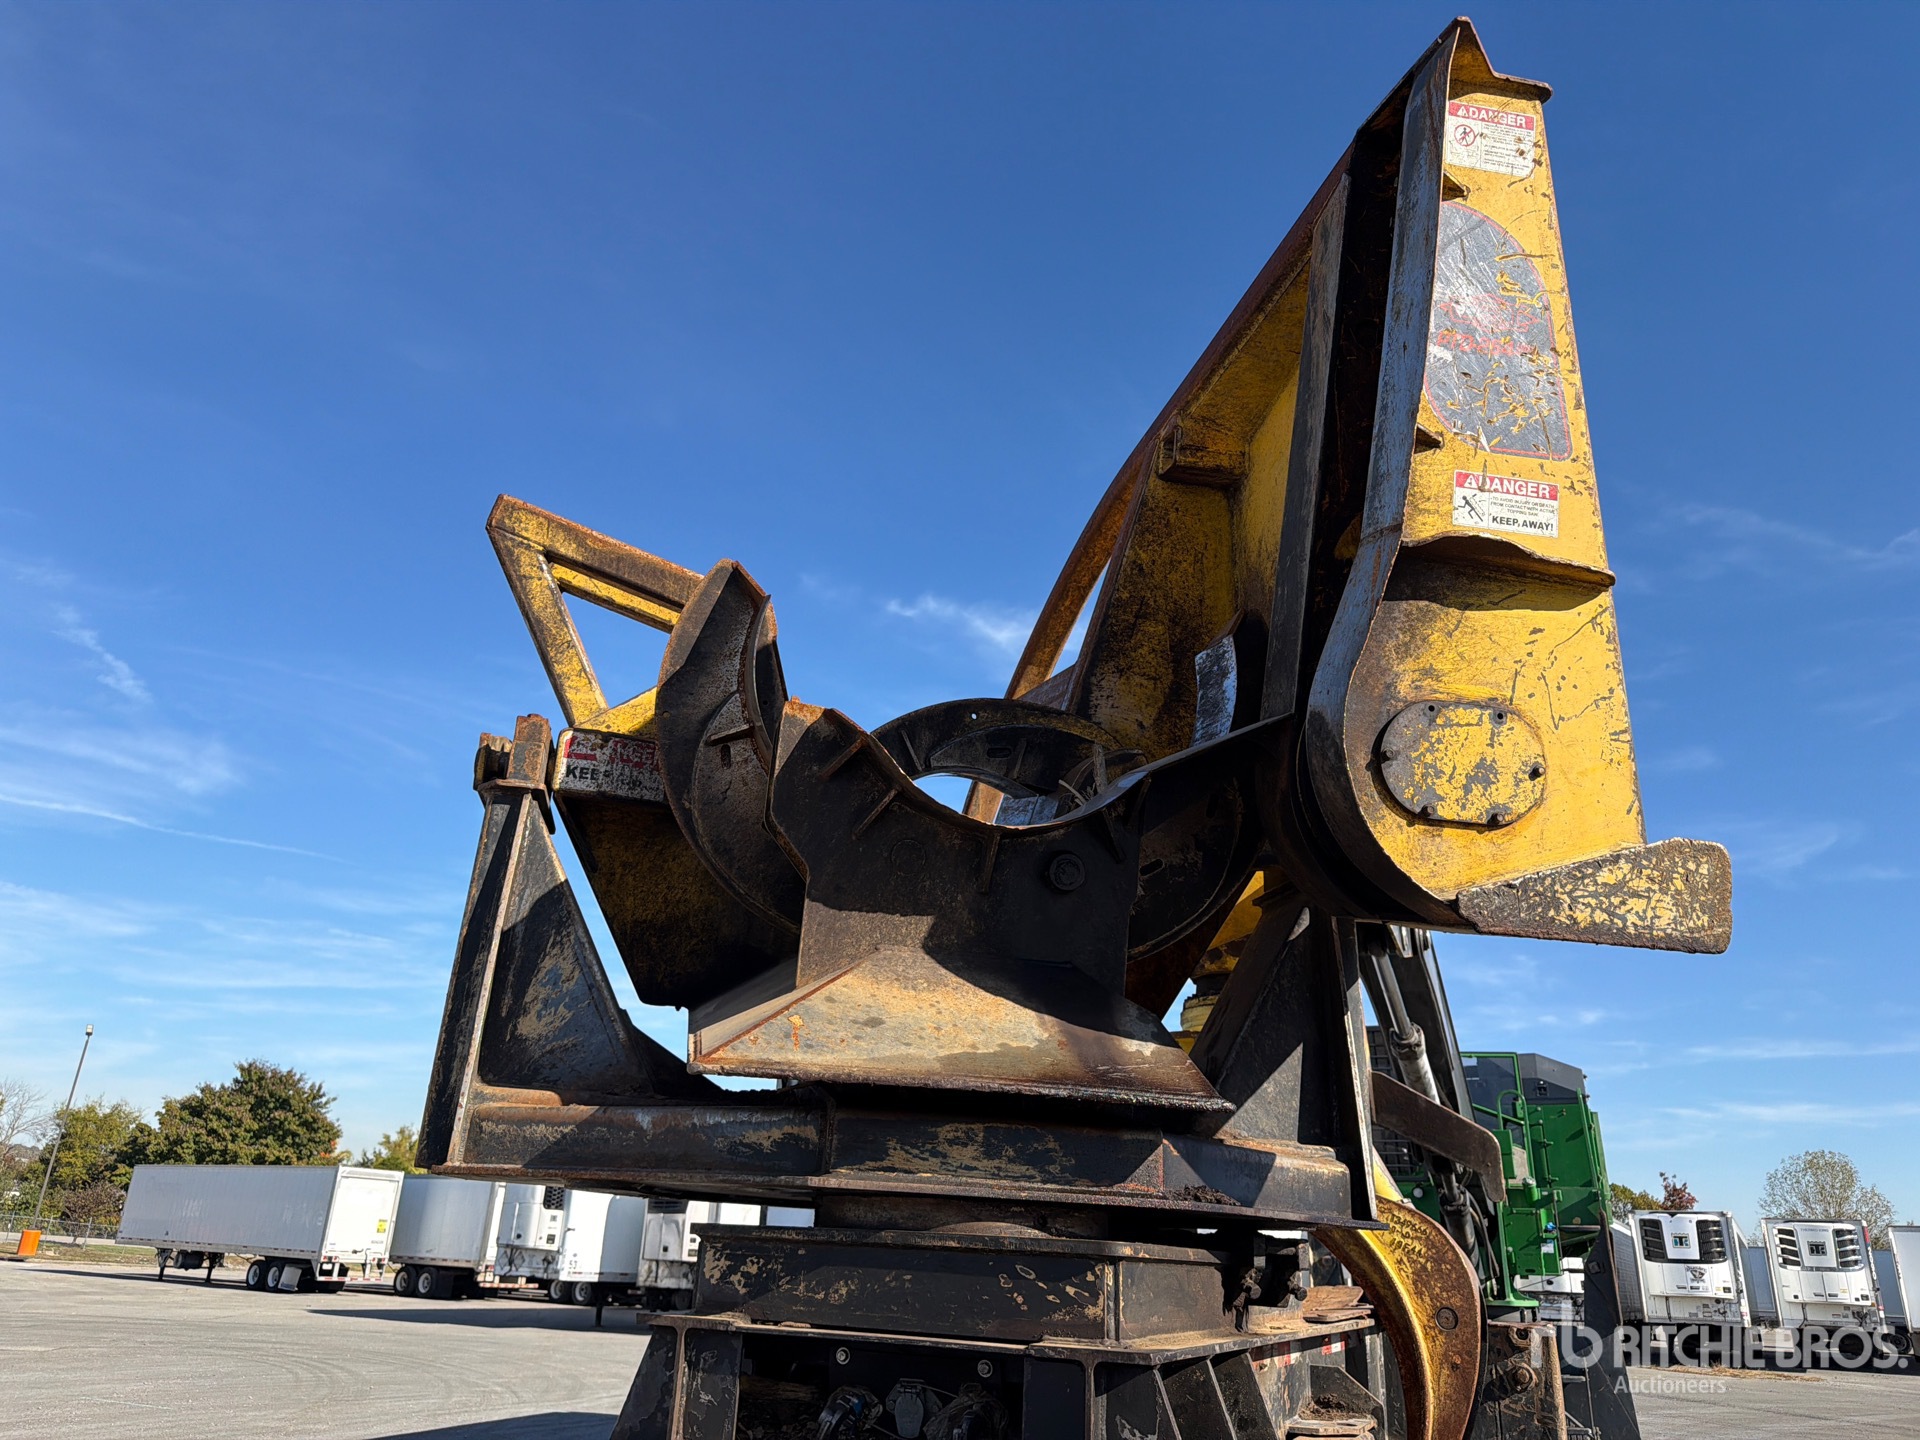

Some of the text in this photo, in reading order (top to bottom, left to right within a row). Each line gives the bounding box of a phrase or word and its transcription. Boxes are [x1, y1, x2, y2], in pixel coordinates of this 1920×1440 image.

[1469, 107, 1526, 127] DANGER
[1479, 477, 1550, 499] DANGER
[1522, 520, 1553, 531] AWAY!
